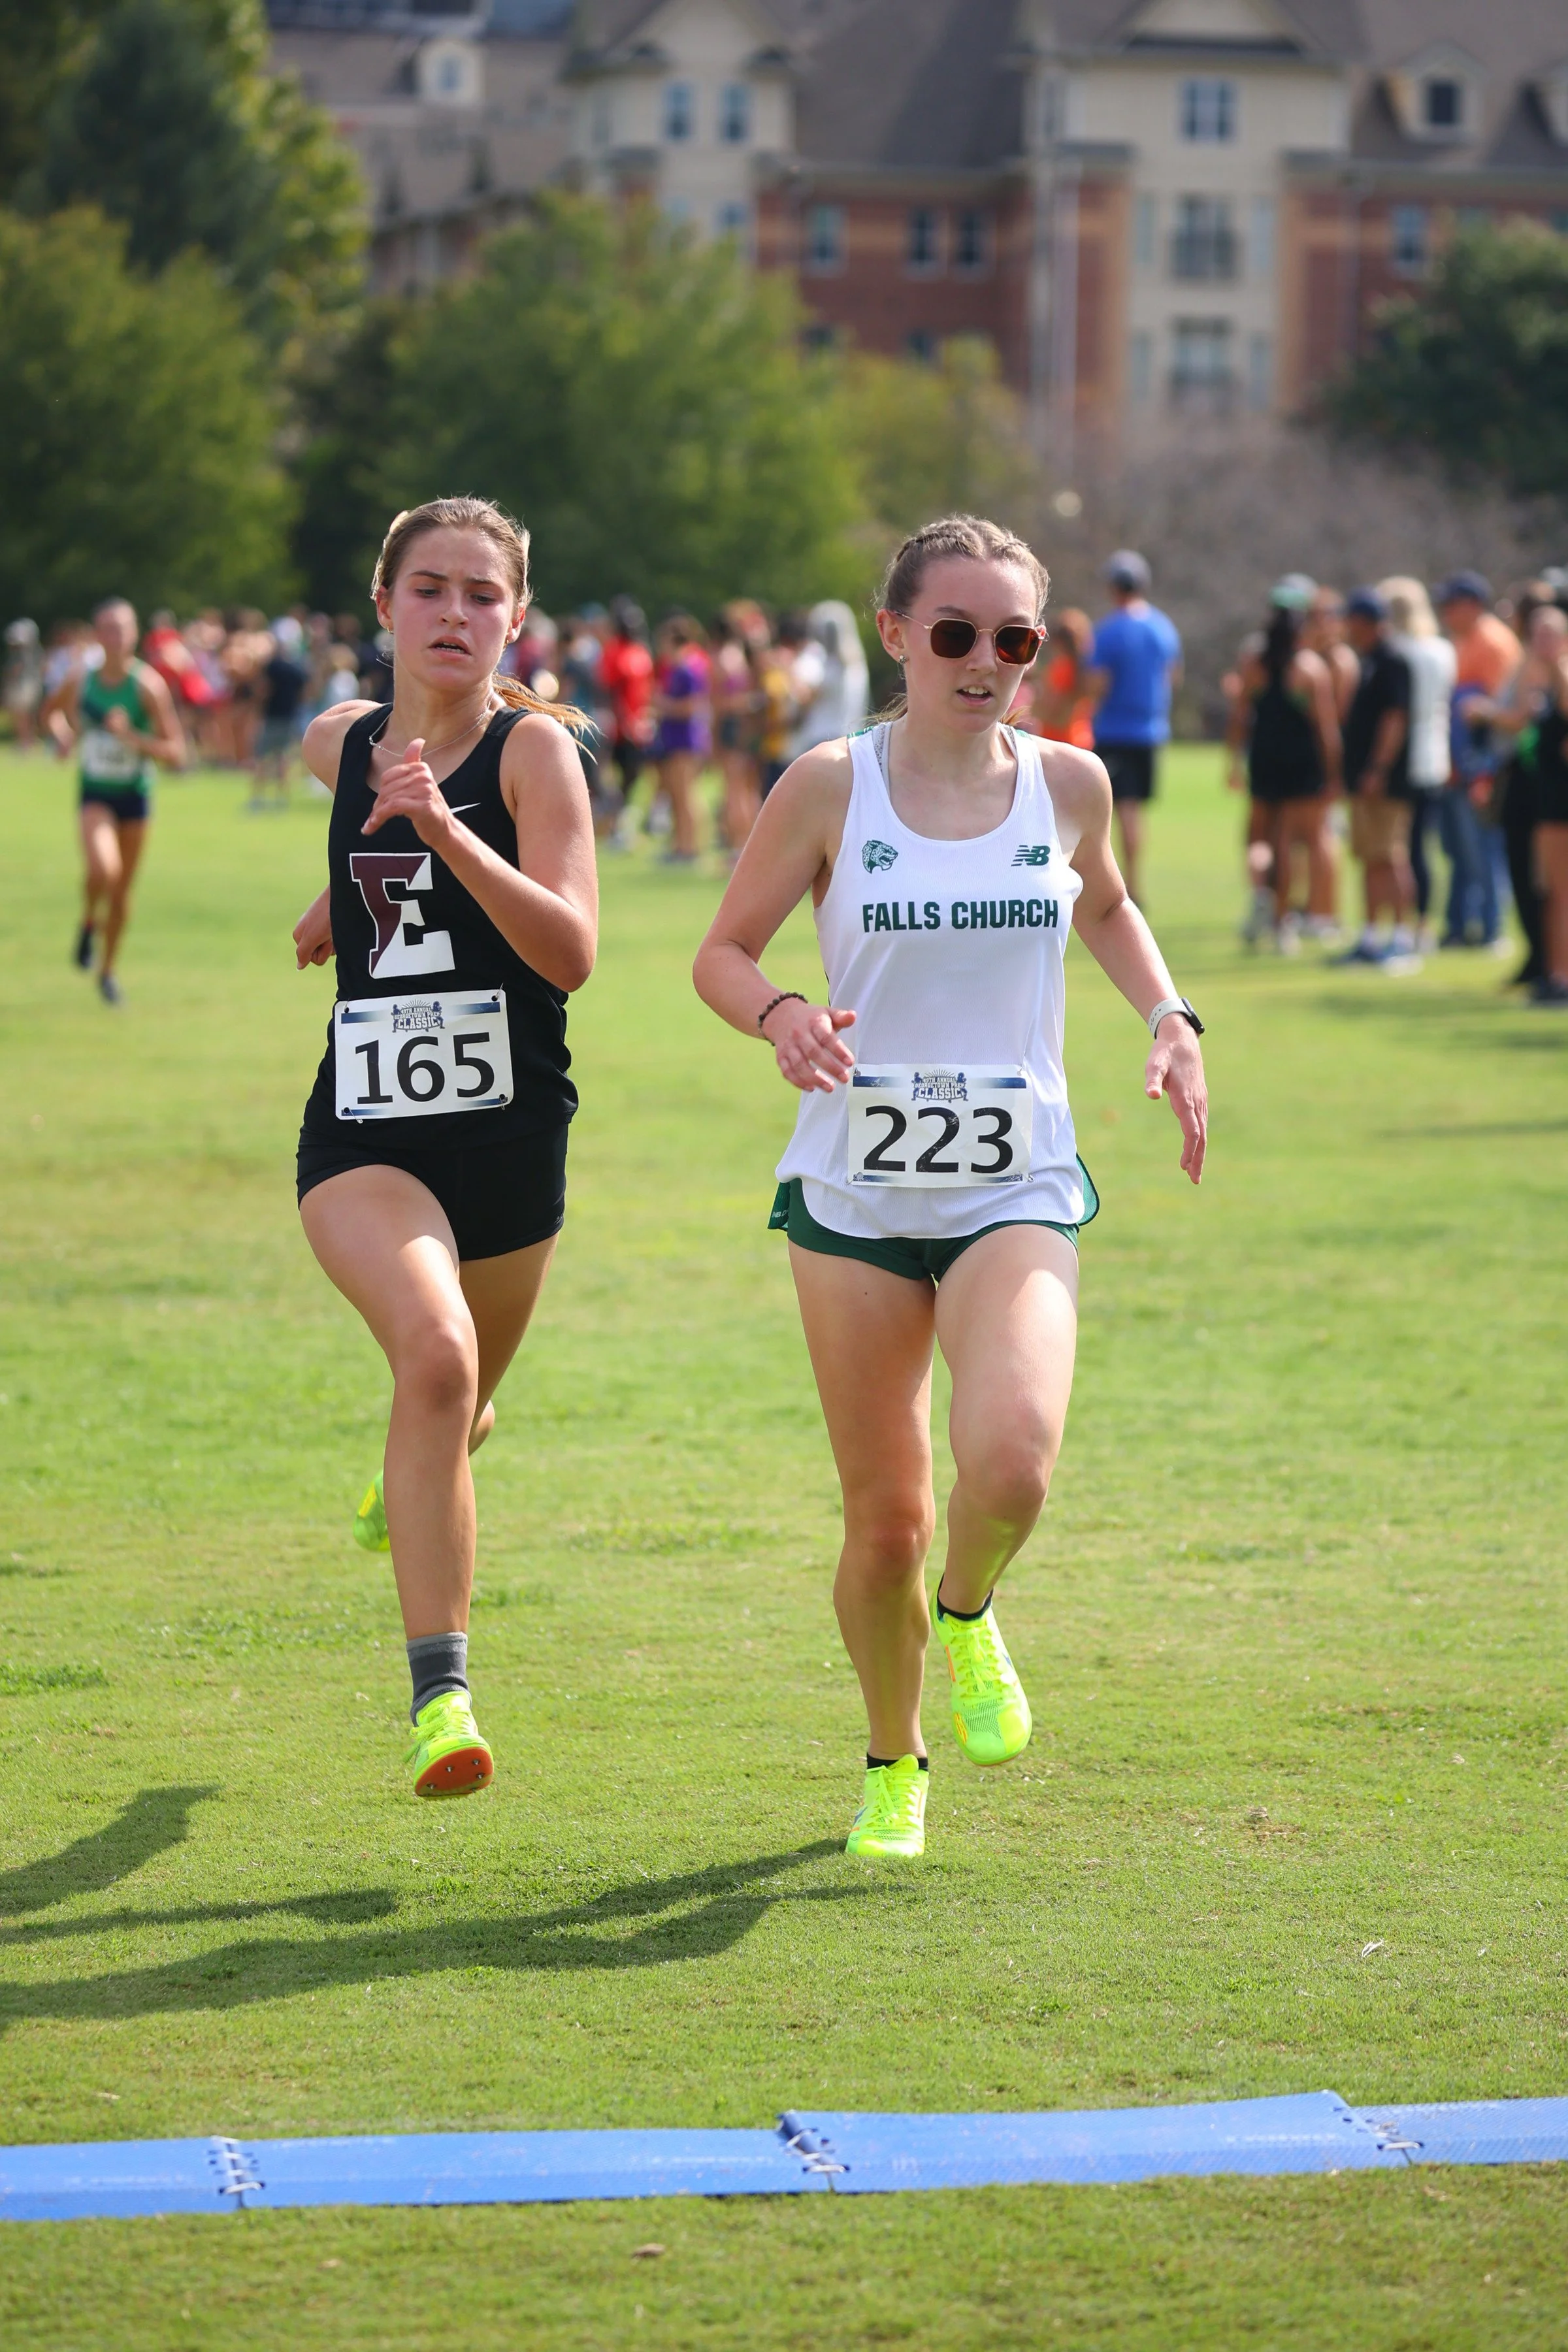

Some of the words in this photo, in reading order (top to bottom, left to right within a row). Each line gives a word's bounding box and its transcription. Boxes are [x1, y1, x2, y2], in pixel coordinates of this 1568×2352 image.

[349, 852, 455, 979] E
[862, 901, 941, 933] FALLS
[951, 898, 1058, 930] CHURCH
[397, 1017, 438, 1029] CLASSIC
[355, 1032, 495, 1105] 165
[917, 1088, 962, 1099] CLASSIC
[863, 1105, 1013, 1174] 223
